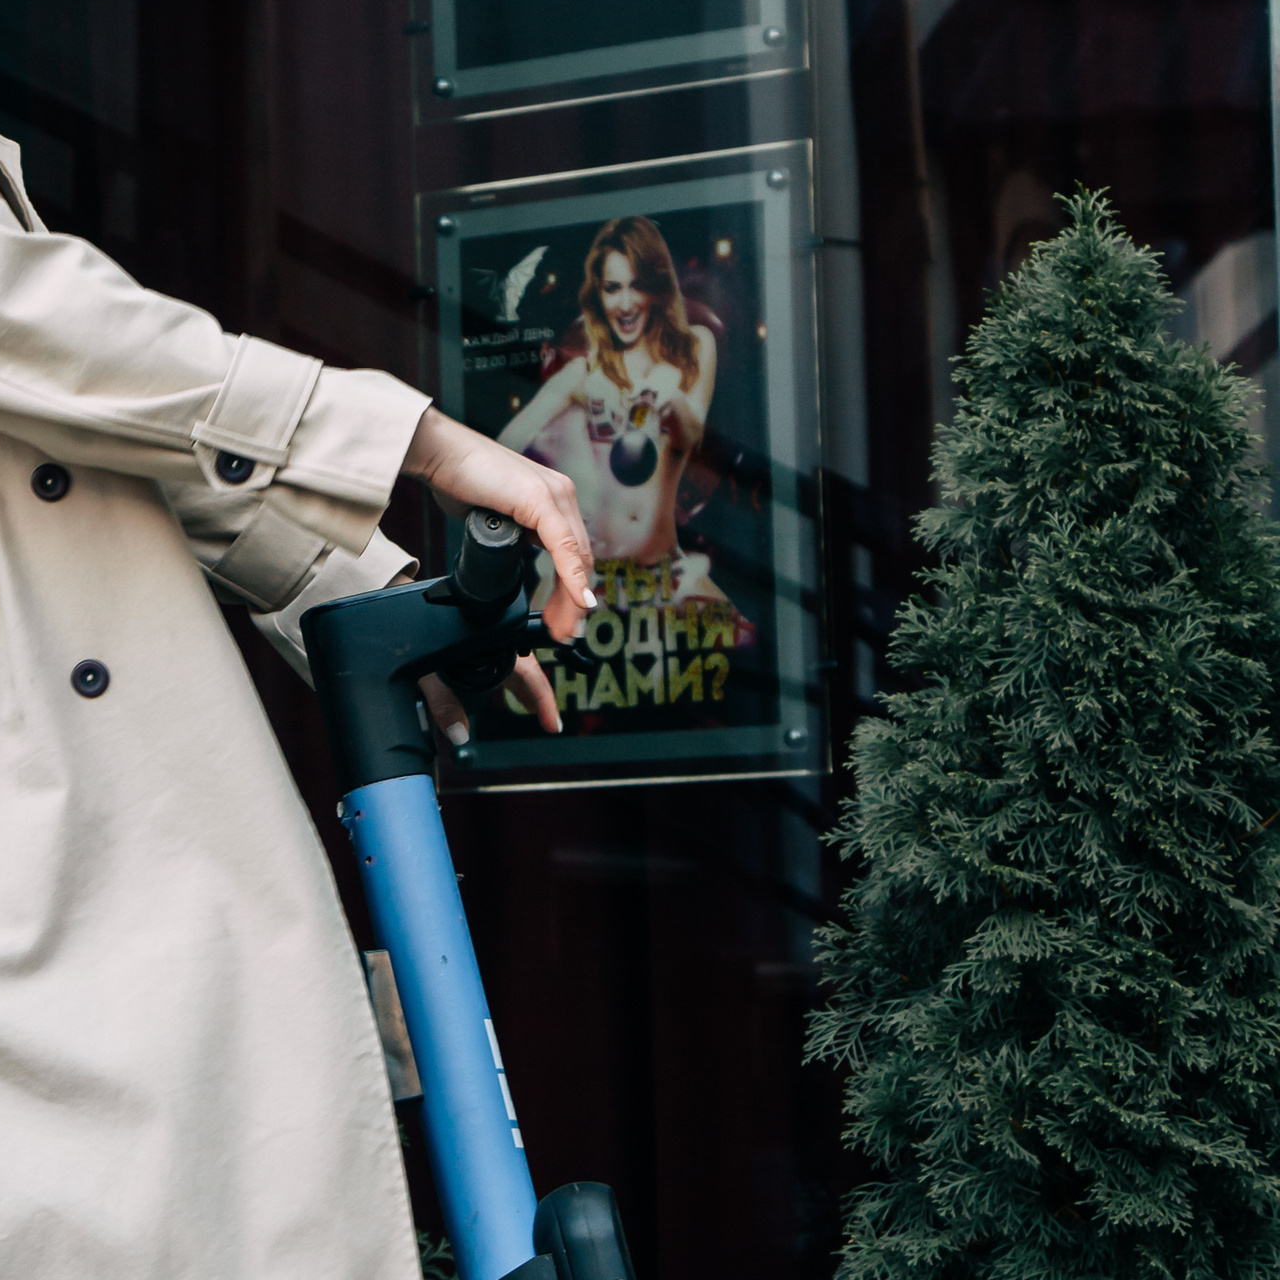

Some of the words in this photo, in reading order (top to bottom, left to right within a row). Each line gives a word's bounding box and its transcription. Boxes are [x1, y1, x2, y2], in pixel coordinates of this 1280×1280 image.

[462, 327, 519, 346] КАЖДЫЙ
[523, 327, 555, 341] ДЕНЬ
[594, 557, 674, 604] ТЫ
[535, 600, 737, 662] ОДНЯ
[554, 651, 730, 711] НАМИ?
